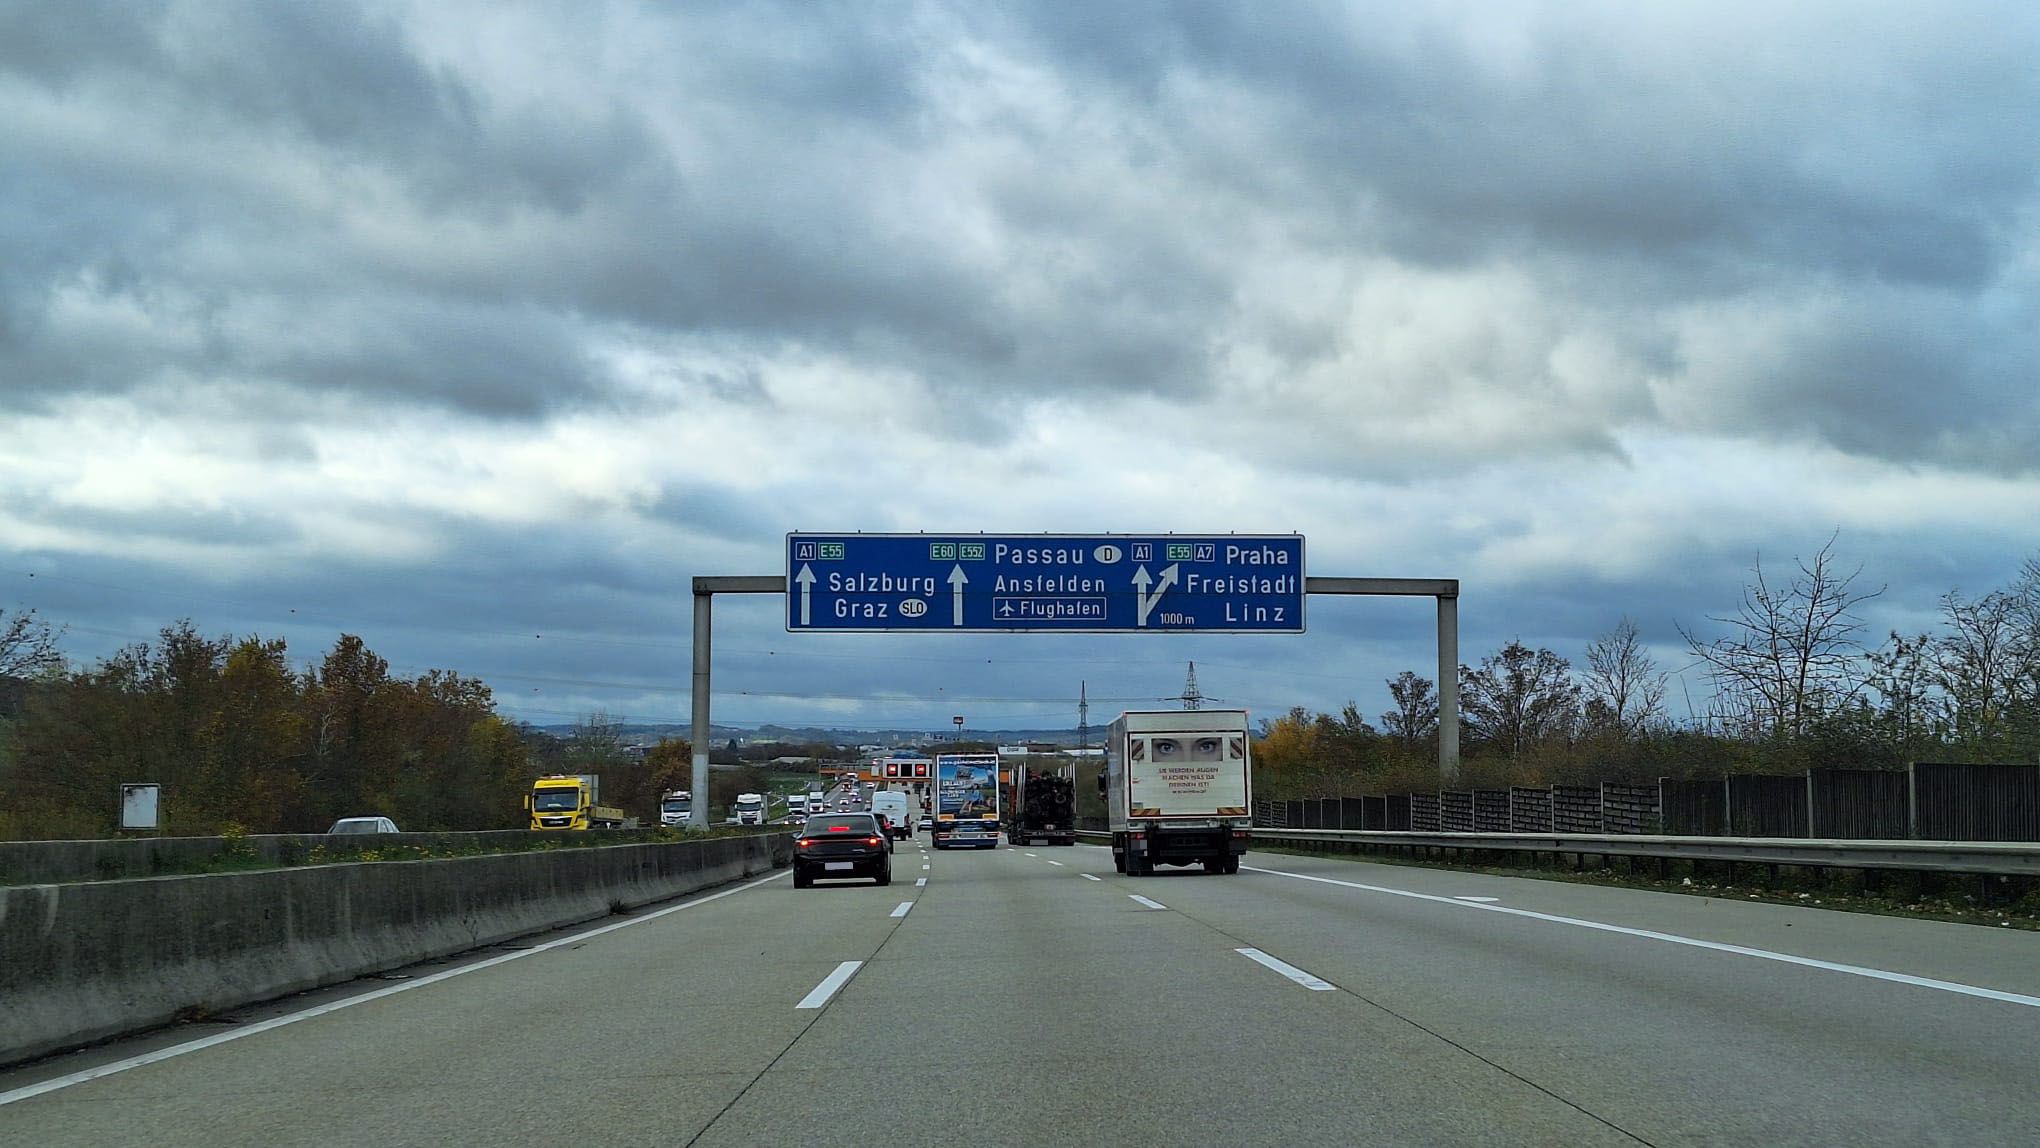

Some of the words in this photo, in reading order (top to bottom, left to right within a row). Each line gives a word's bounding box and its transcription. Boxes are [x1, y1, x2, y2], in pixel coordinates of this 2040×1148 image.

[799, 545, 813, 558] A1
[820, 545, 842, 558] E55
[932, 546, 954, 558] E60
[961, 546, 983, 558] E552
[995, 544, 1084, 565] Passau
[1104, 548, 1113, 561] D
[1136, 546, 1148, 559] A1
[1169, 547, 1191, 559] E55
[1196, 547, 1212, 559] A7
[1226, 545, 1288, 565] Praha
[829, 572, 935, 597] Salzburg
[994, 575, 1105, 593] Ansfelden
[1187, 574, 1296, 594] Freistadt
[835, 598, 888, 618] Graz
[902, 601, 924, 614] SLO
[1021, 601, 1101, 619] Flughafen
[1225, 603, 1284, 622] Linz
[1160, 612, 1183, 625] 1000
[1185, 615, 1195, 625] m
